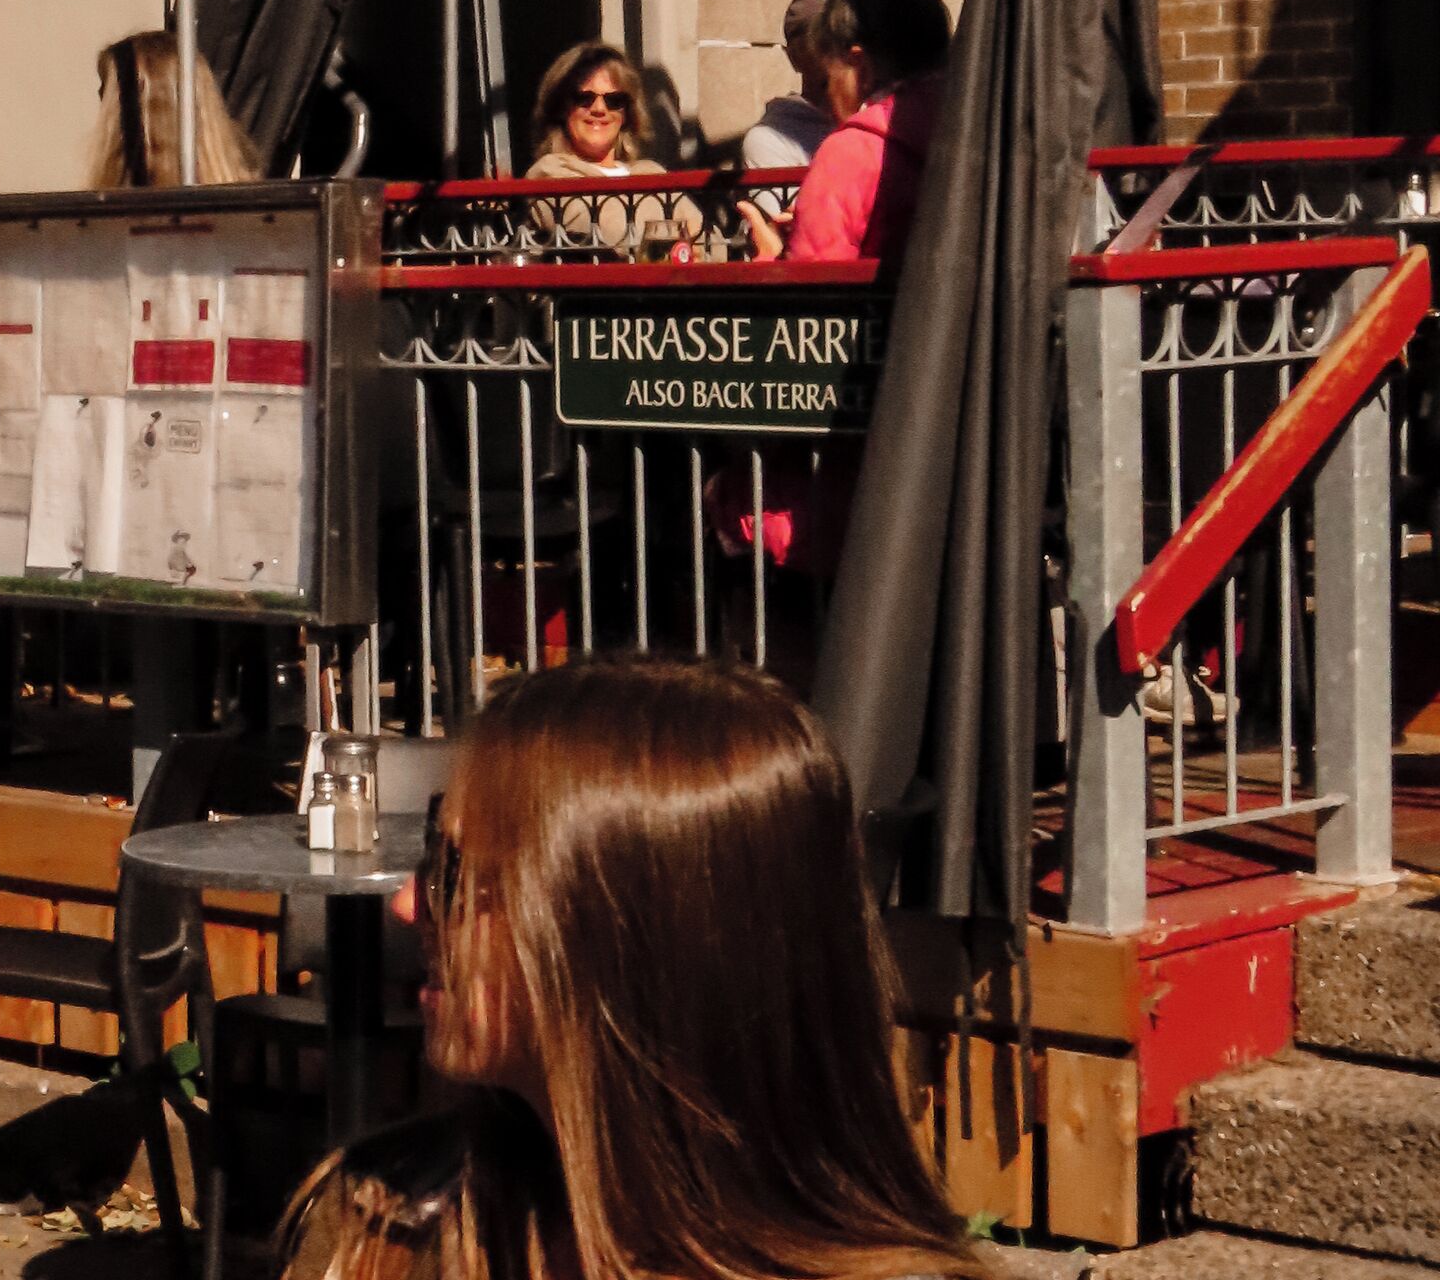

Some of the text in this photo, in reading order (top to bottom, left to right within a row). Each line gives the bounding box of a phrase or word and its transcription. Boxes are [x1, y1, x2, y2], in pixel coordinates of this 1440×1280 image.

[571, 317, 754, 362] TERRASSE
[625, 379, 858, 412] ALSO BACK TERRA
